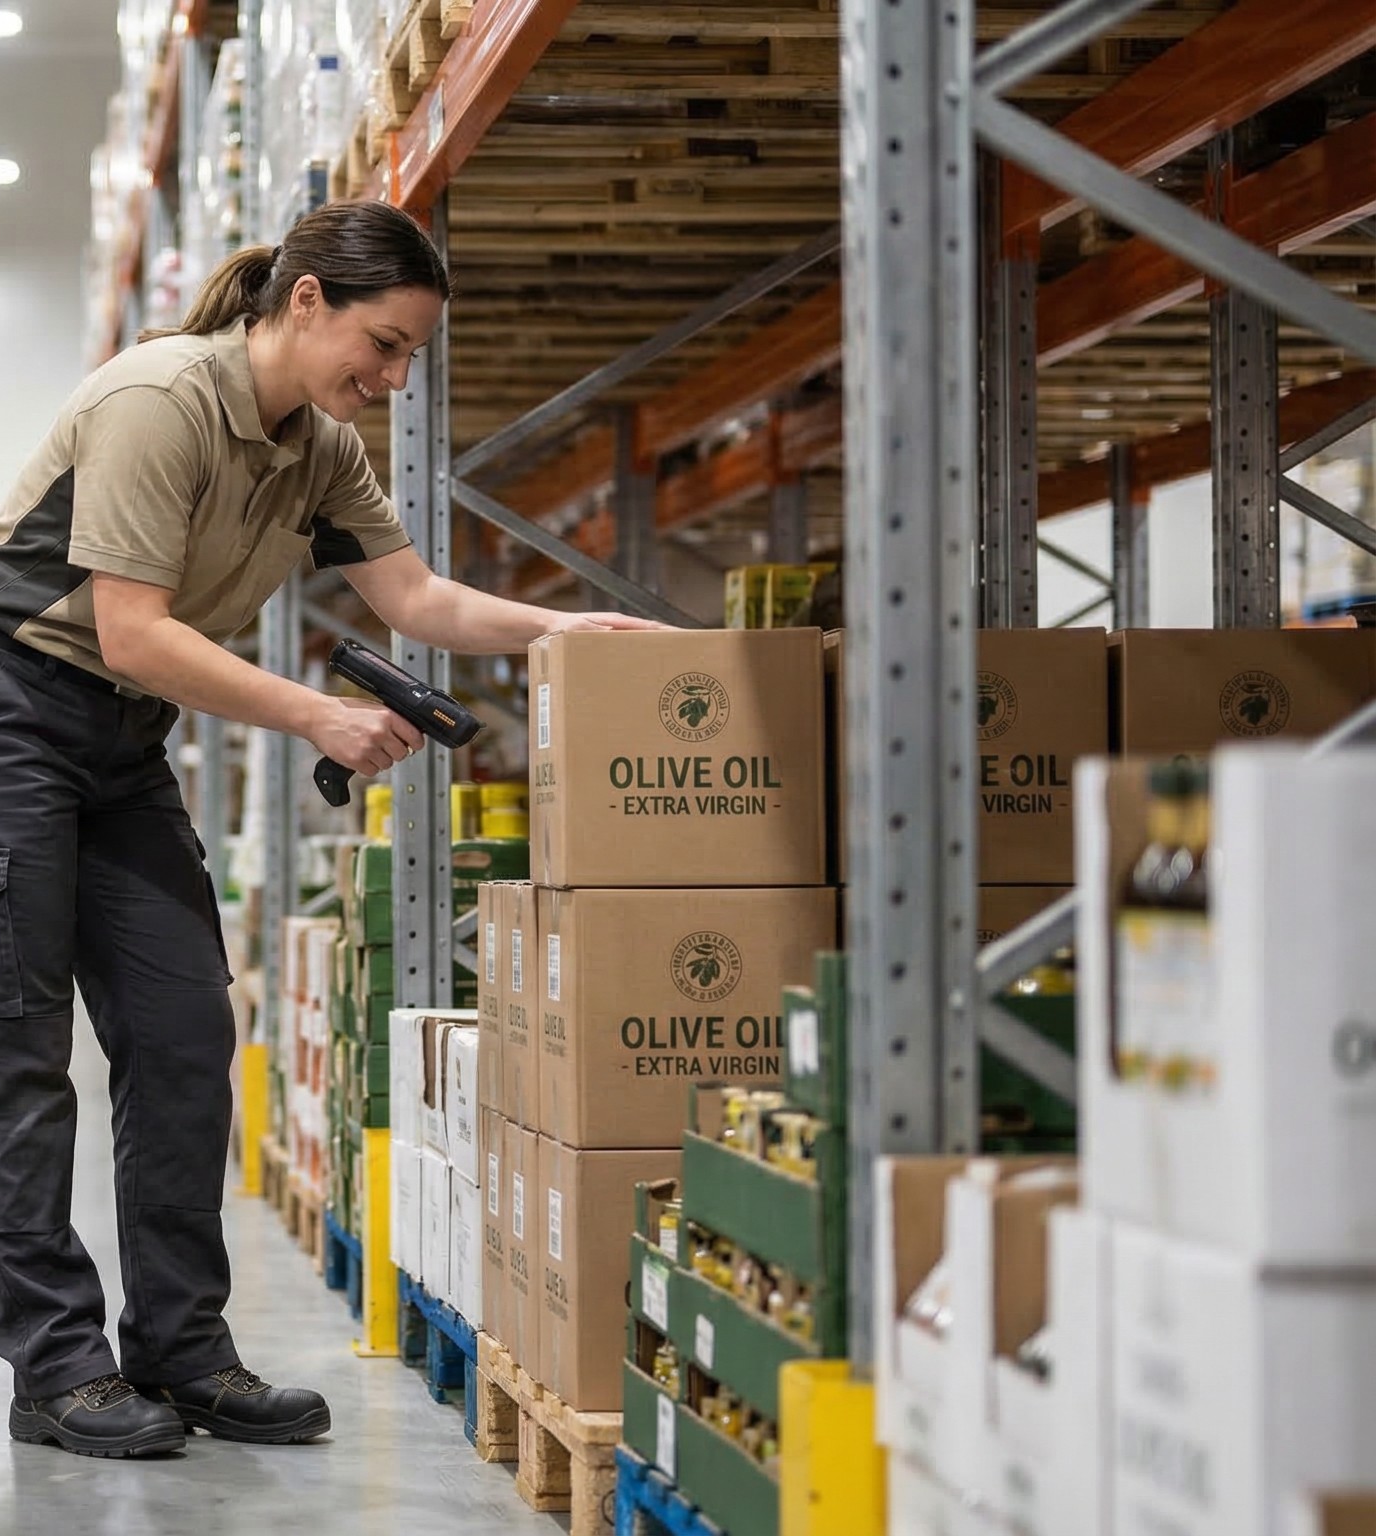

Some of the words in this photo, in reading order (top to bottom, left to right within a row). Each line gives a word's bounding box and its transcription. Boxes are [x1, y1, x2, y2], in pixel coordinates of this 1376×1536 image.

[609, 756, 713, 789] OLIVE
[723, 756, 783, 789] OIL
[1010, 754, 1068, 787] OIL
[624, 795, 691, 815] EXTRA
[695, 795, 766, 815] VIRGIN
[982, 793, 1052, 813] VIRGIN
[621, 1016, 725, 1049] OLIVE
[635, 1056, 702, 1075] EXTRA
[708, 1056, 780, 1075] VIRGIN
